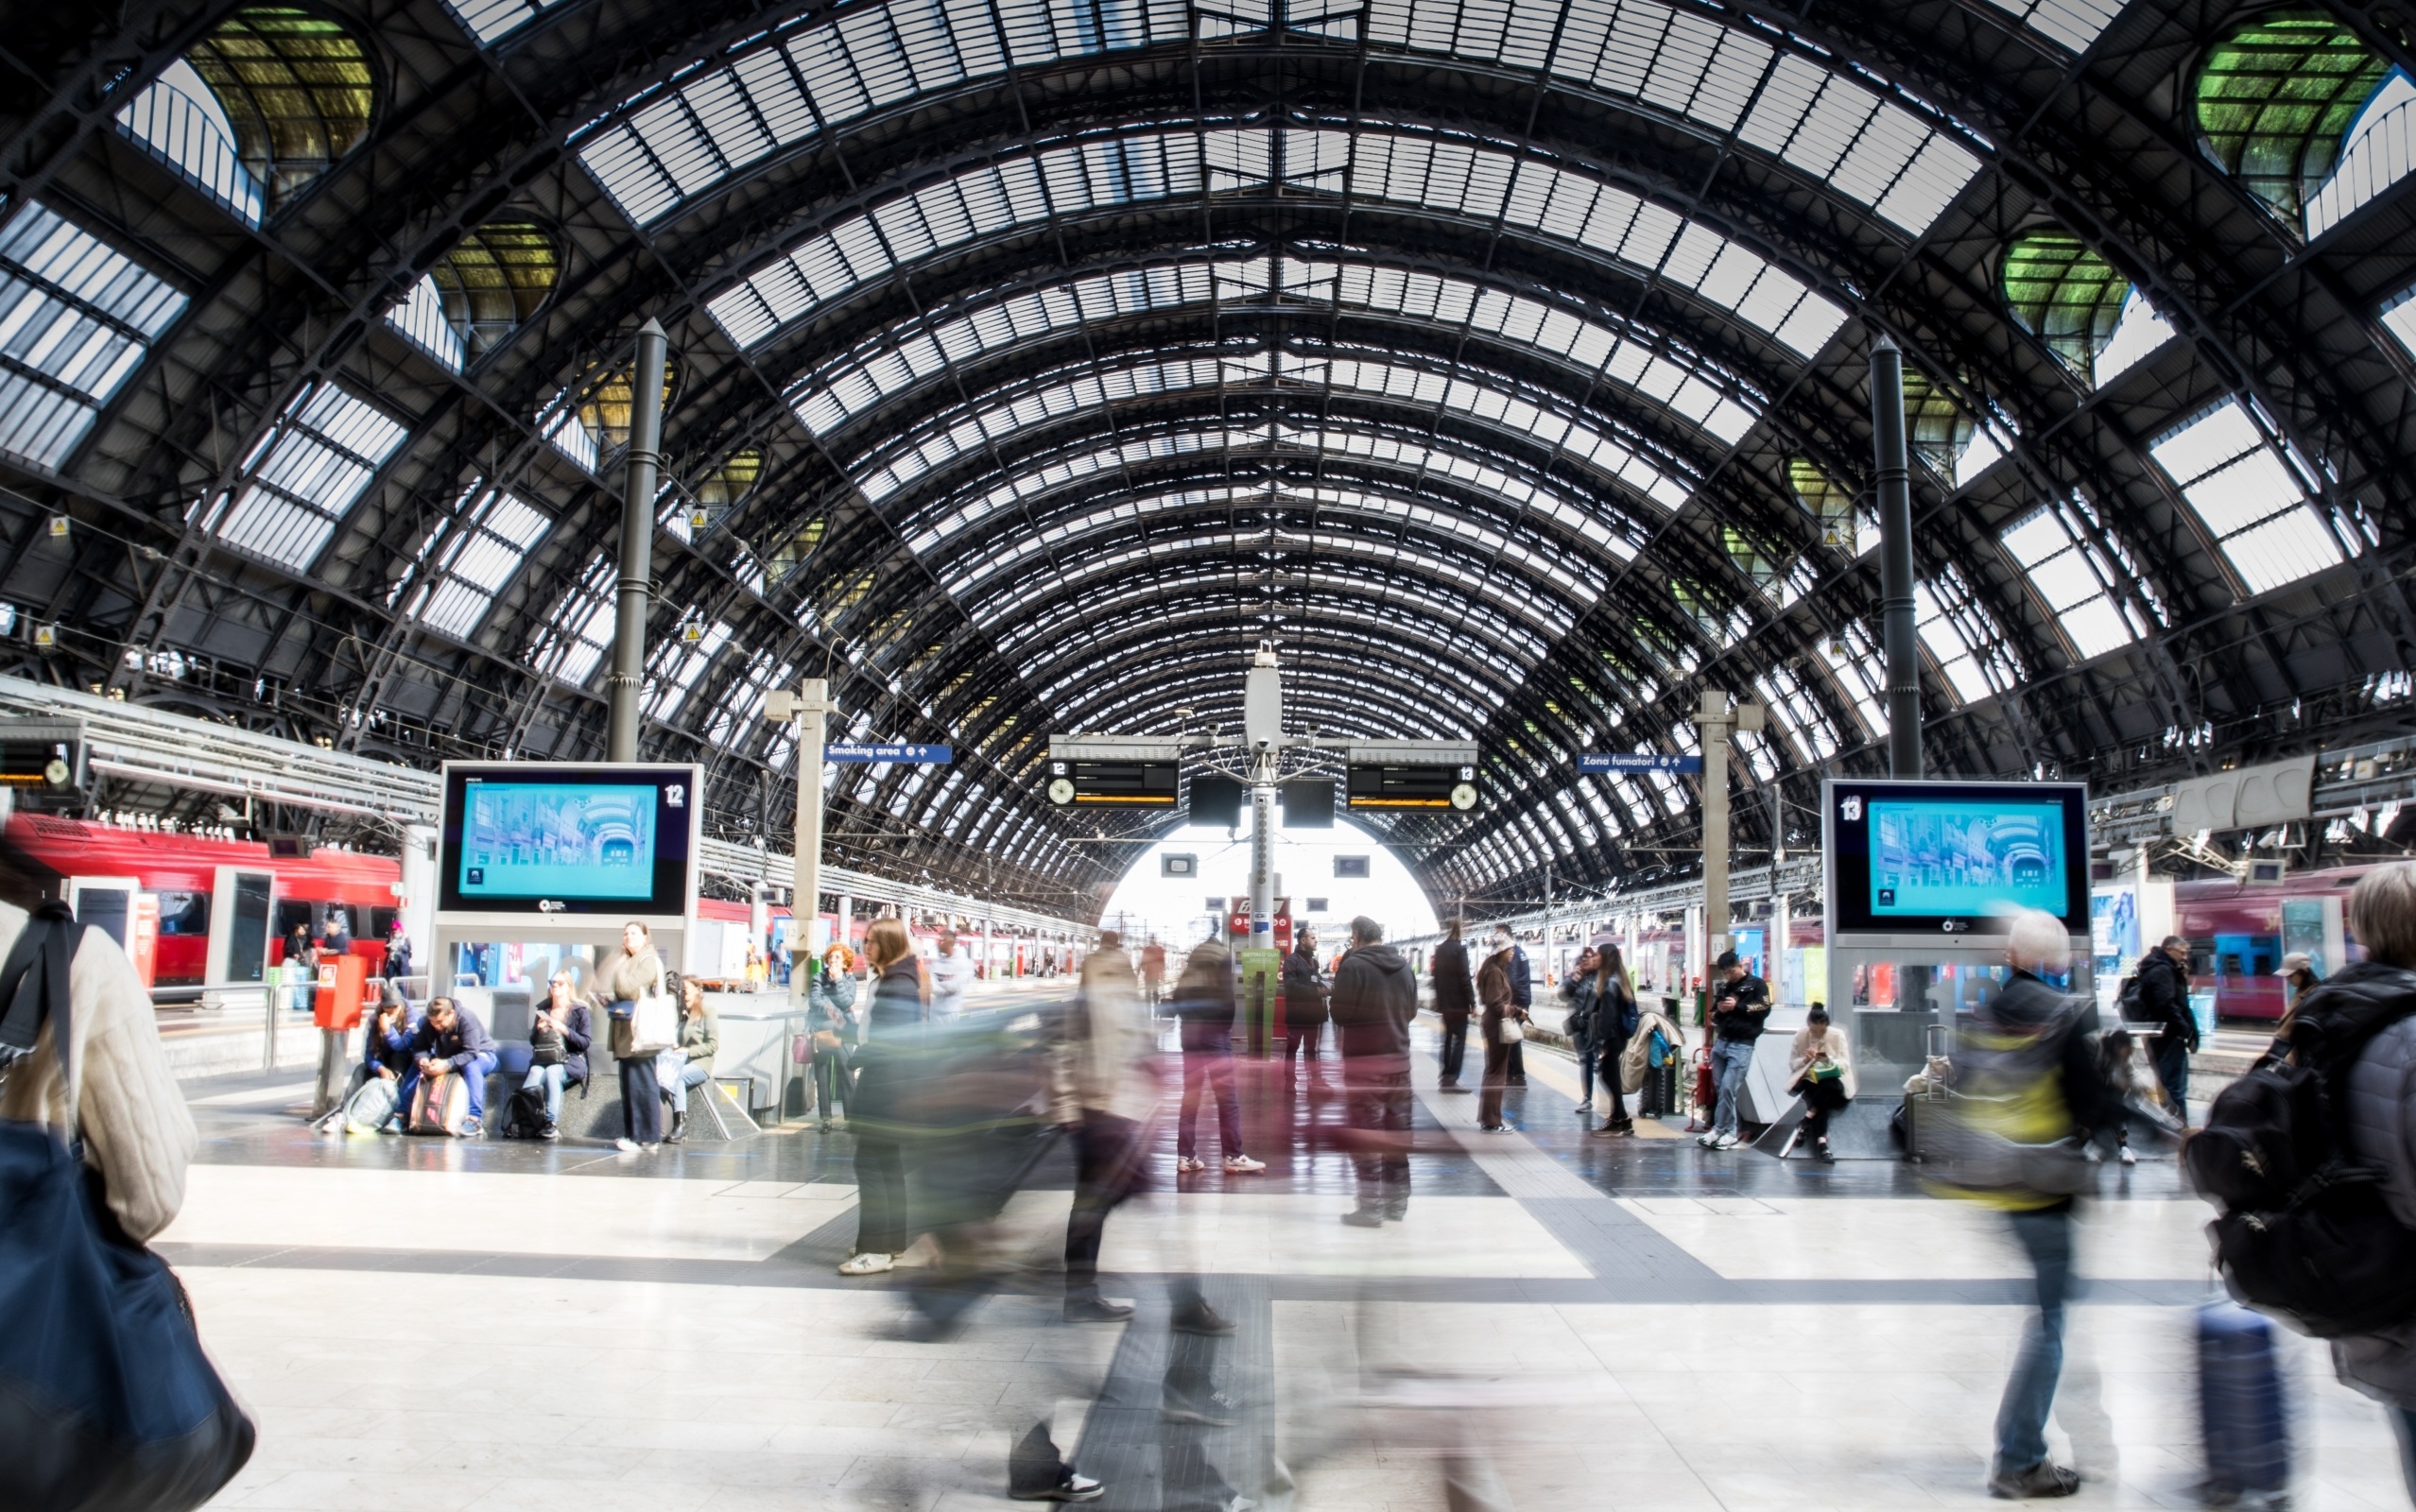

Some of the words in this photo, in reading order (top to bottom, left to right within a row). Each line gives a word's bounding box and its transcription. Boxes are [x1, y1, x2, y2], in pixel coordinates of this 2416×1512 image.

[828, 745, 873, 758] Smoking
[876, 747, 901, 756] area
[1583, 756, 1609, 765] Zona
[1612, 756, 1655, 766] fumatori
[1053, 763, 1066, 775] 12
[1460, 766, 1474, 781] 13
[664, 784, 684, 803] 12
[1840, 800, 1861, 820] 13
[786, 928, 796, 936] 12
[1713, 942, 1724, 952] 13
